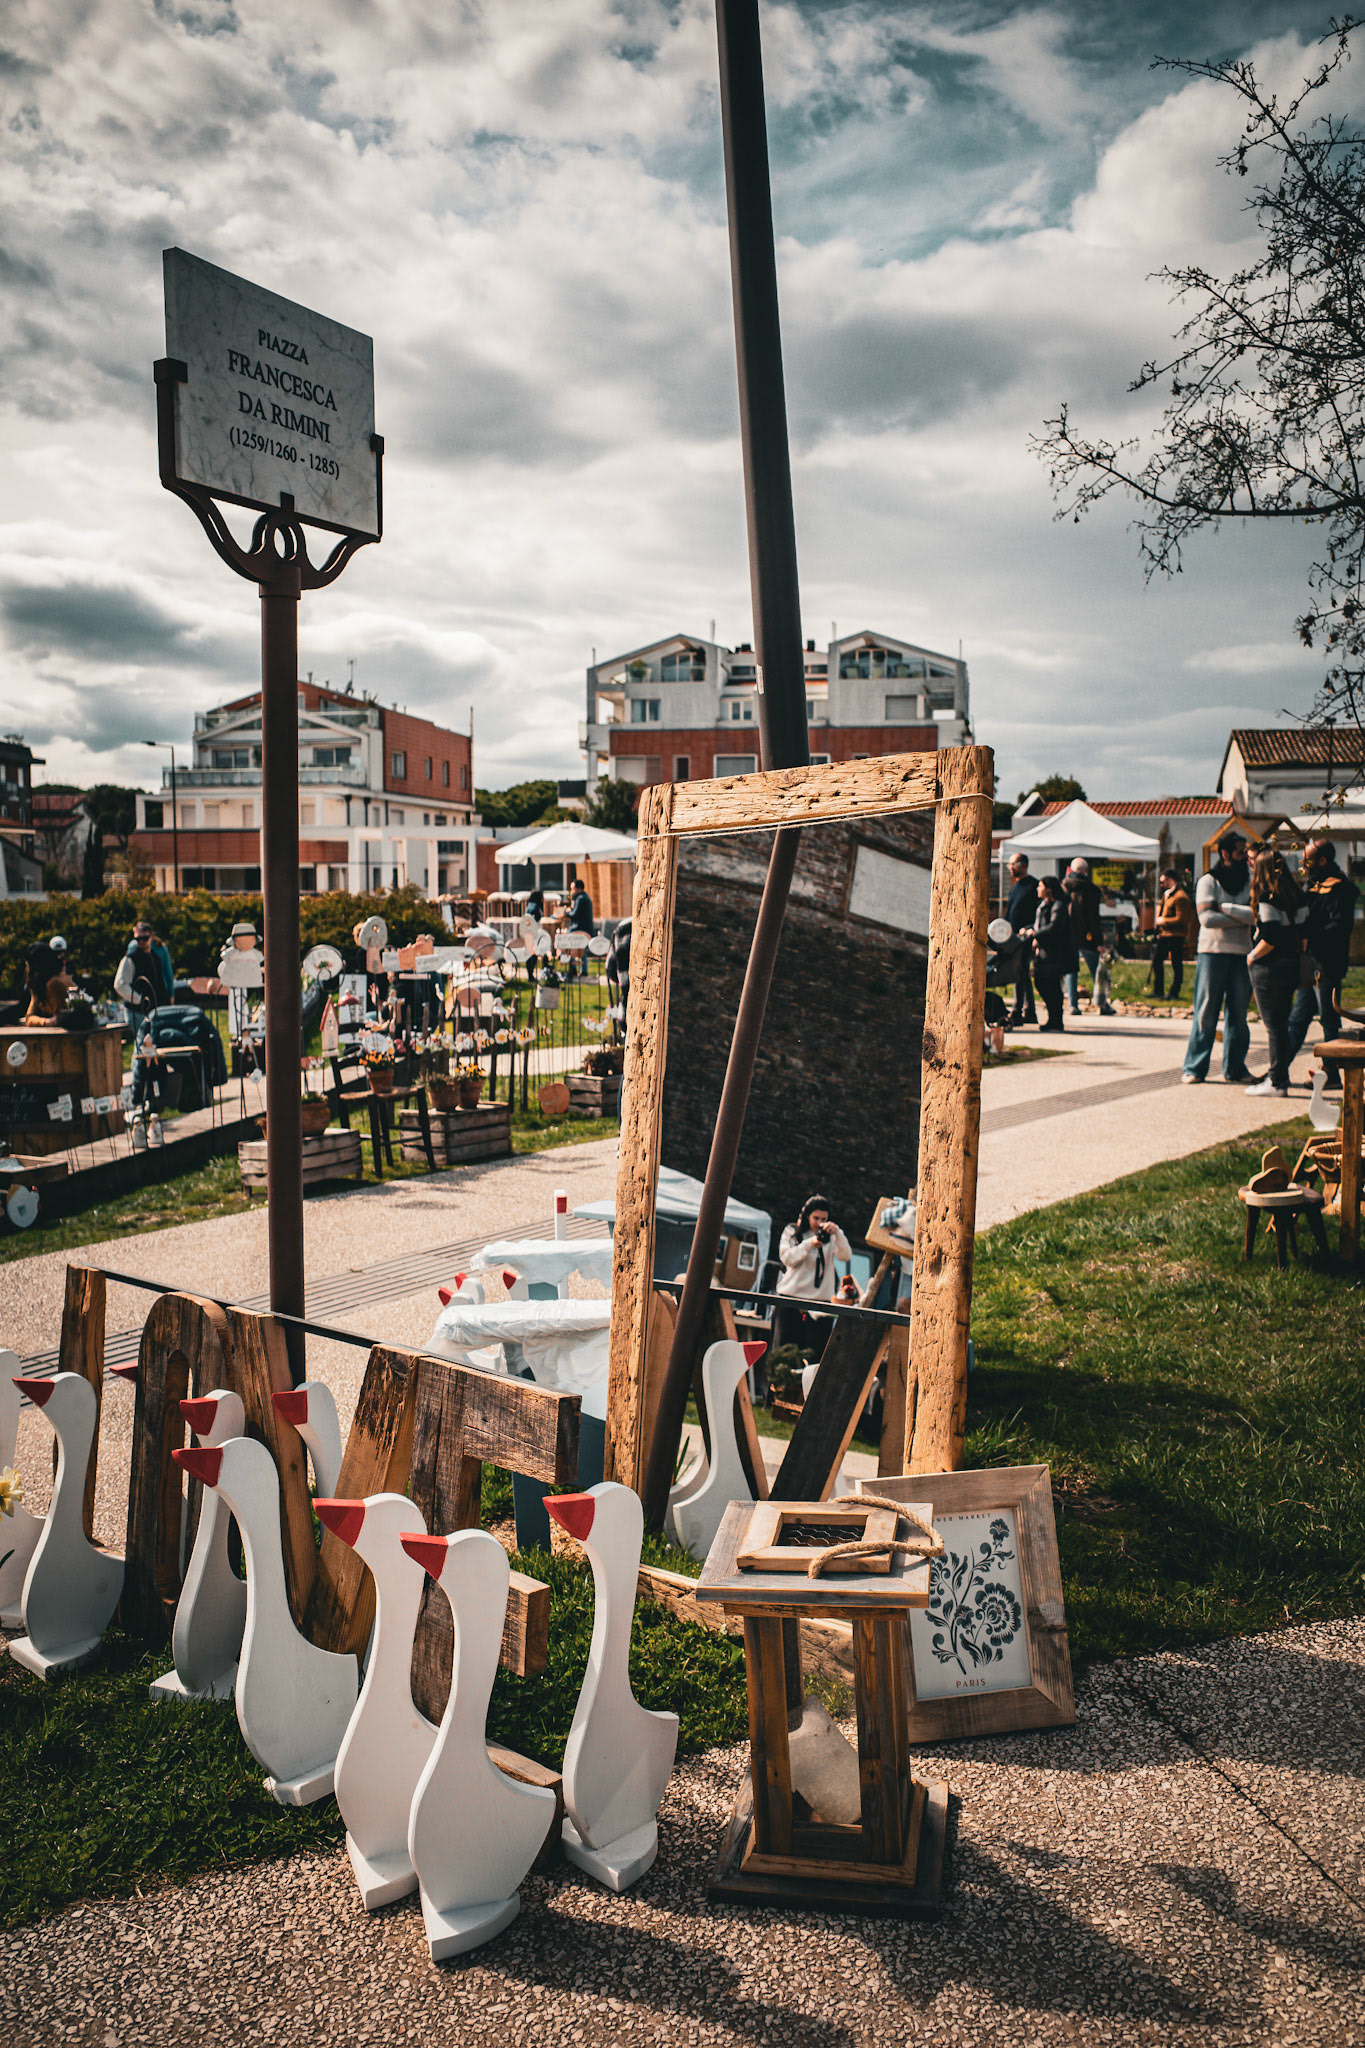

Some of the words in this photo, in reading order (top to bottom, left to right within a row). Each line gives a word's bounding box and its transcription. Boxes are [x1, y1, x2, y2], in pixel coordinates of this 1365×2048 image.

[257, 328, 310, 365] PIAZZA
[227, 348, 338, 411] FRANCESCA
[238, 390, 266, 421] DA
[271, 402, 331, 444] RIMINI
[229, 426, 298, 464] (1259/1260
[309, 453, 340, 480] 1285)
[958, 1512, 991, 1521] MARKET
[955, 1678, 987, 1689] PARIS
